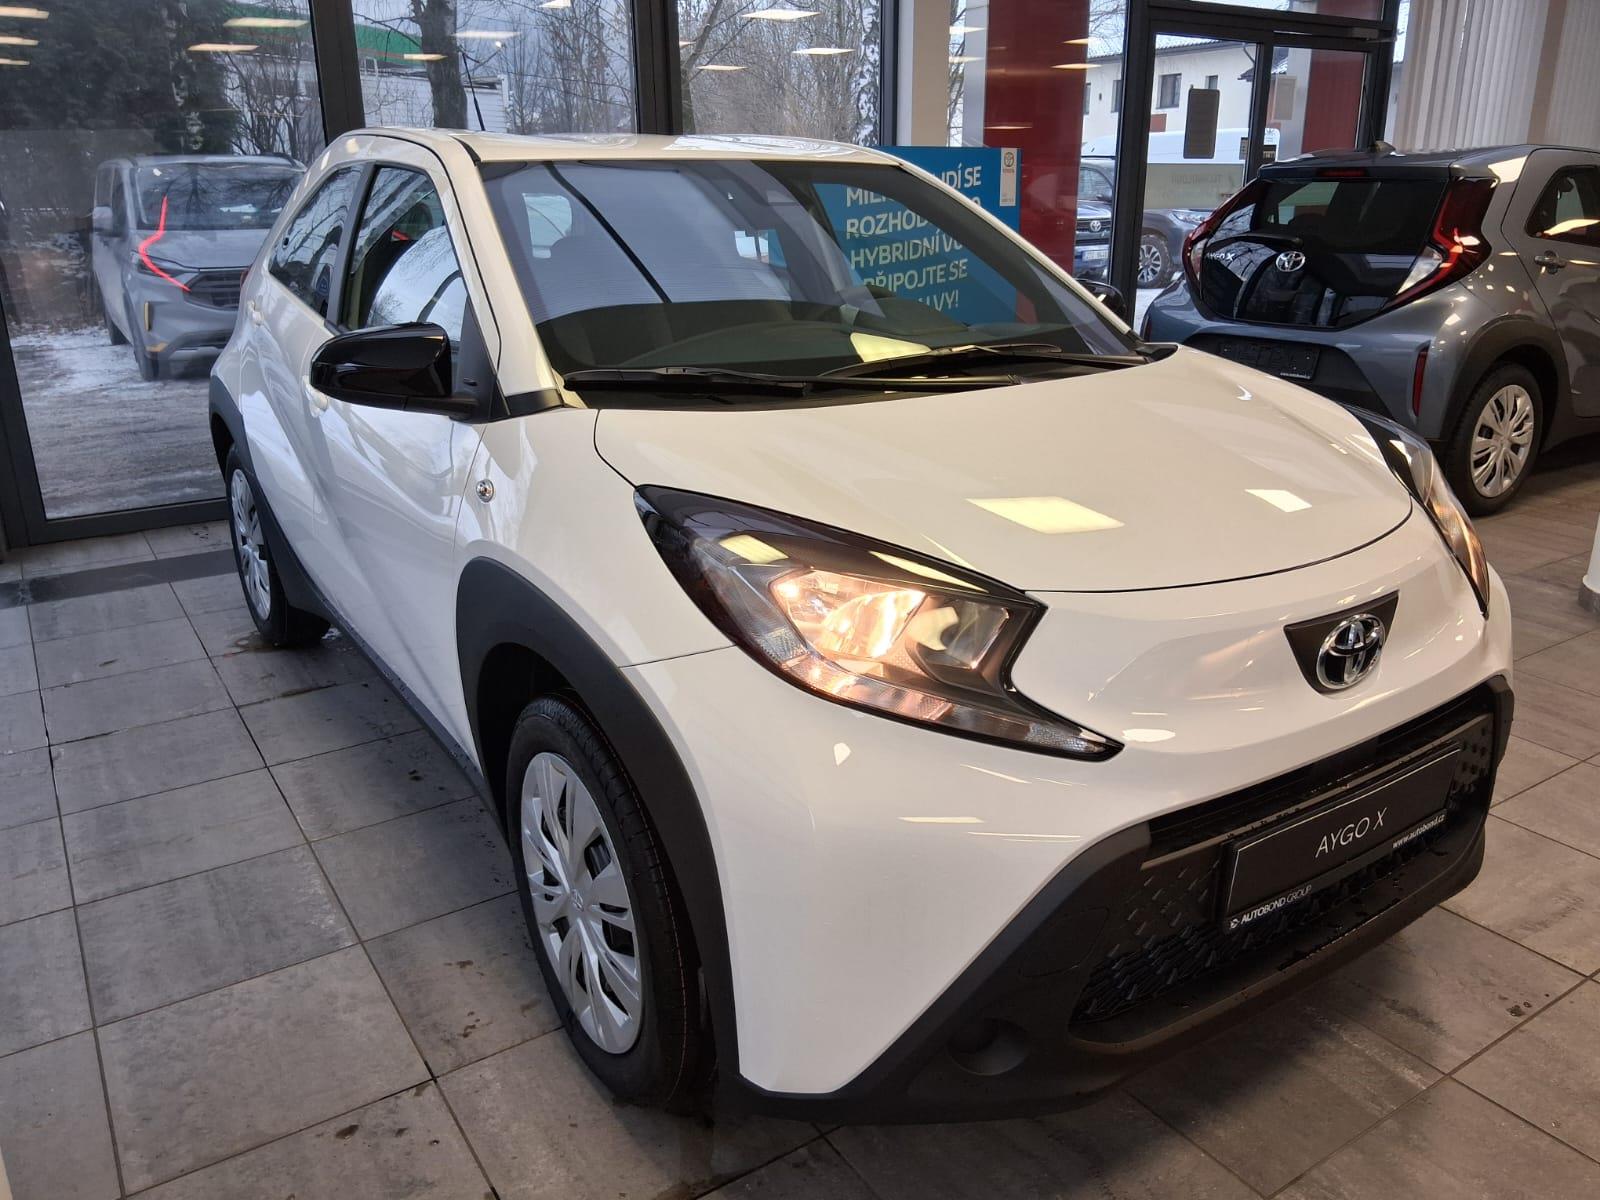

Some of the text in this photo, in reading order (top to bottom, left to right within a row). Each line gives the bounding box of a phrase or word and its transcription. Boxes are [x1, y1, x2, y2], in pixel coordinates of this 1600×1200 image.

[963, 166, 982, 188] SE
[850, 229, 940, 269] HYBRIDNÍ
[948, 258, 969, 281] SE
[933, 289, 960, 312] VY!
[1314, 807, 1388, 858] AYGO X
[1240, 885, 1312, 925] AUTOBOND GROUP
